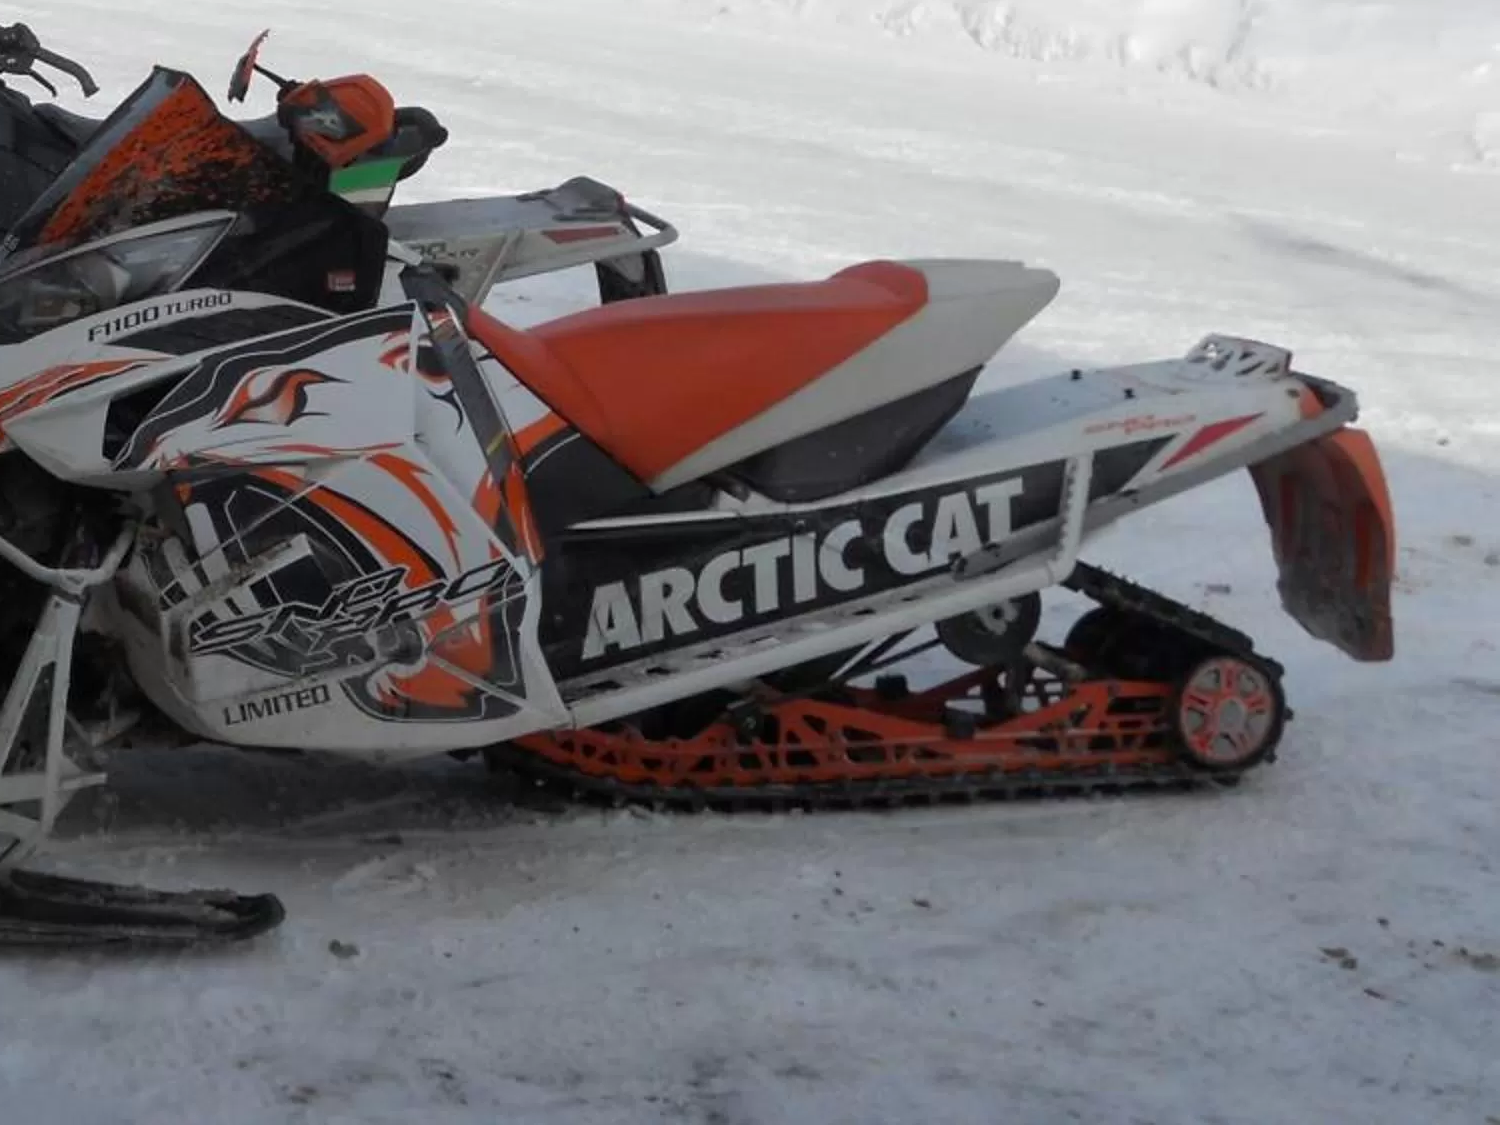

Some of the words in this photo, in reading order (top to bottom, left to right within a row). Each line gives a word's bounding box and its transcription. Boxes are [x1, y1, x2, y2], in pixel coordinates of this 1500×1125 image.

[88, 306, 160, 342] F1100
[164, 292, 232, 316] TURBO
[581, 518, 865, 661] ARCTIC
[883, 477, 1025, 575] CAT
[223, 683, 331, 726] LIMITED
